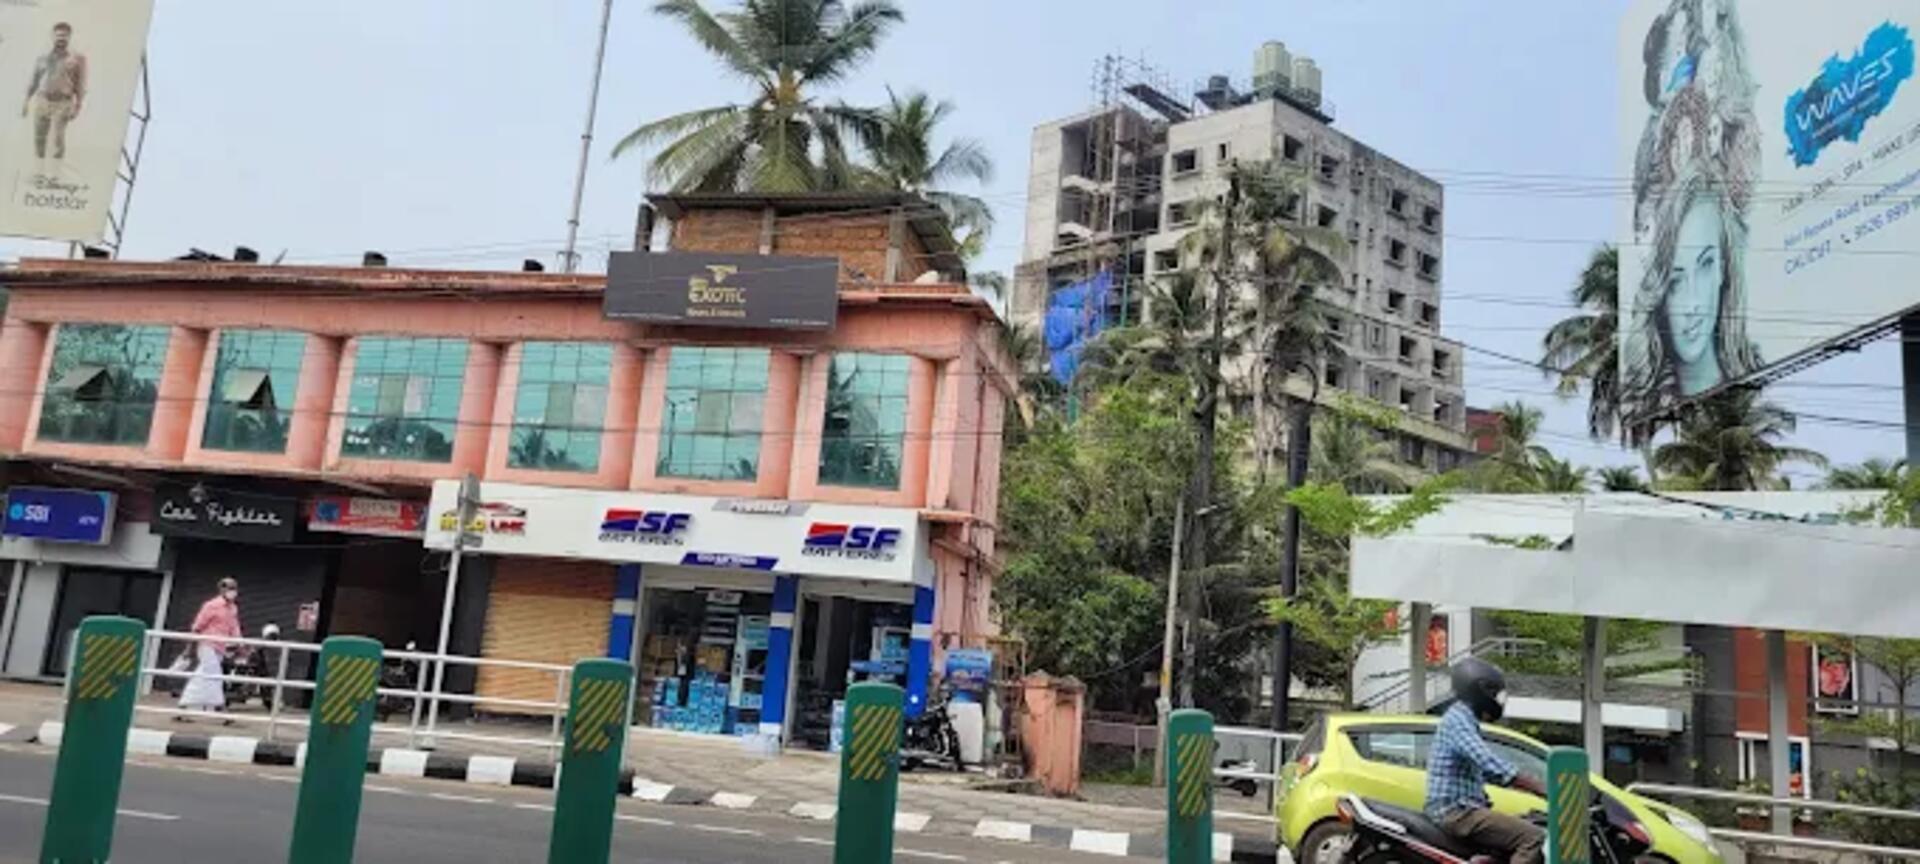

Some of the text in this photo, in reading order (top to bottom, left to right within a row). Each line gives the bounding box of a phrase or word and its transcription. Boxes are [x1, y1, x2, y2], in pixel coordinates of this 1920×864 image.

[1795, 47, 1898, 130] WAVES
[24, 192, 89, 210] hotstar
[24, 504, 50, 523] SBI
[638, 510, 693, 535] SF
[846, 527, 902, 550] SF
